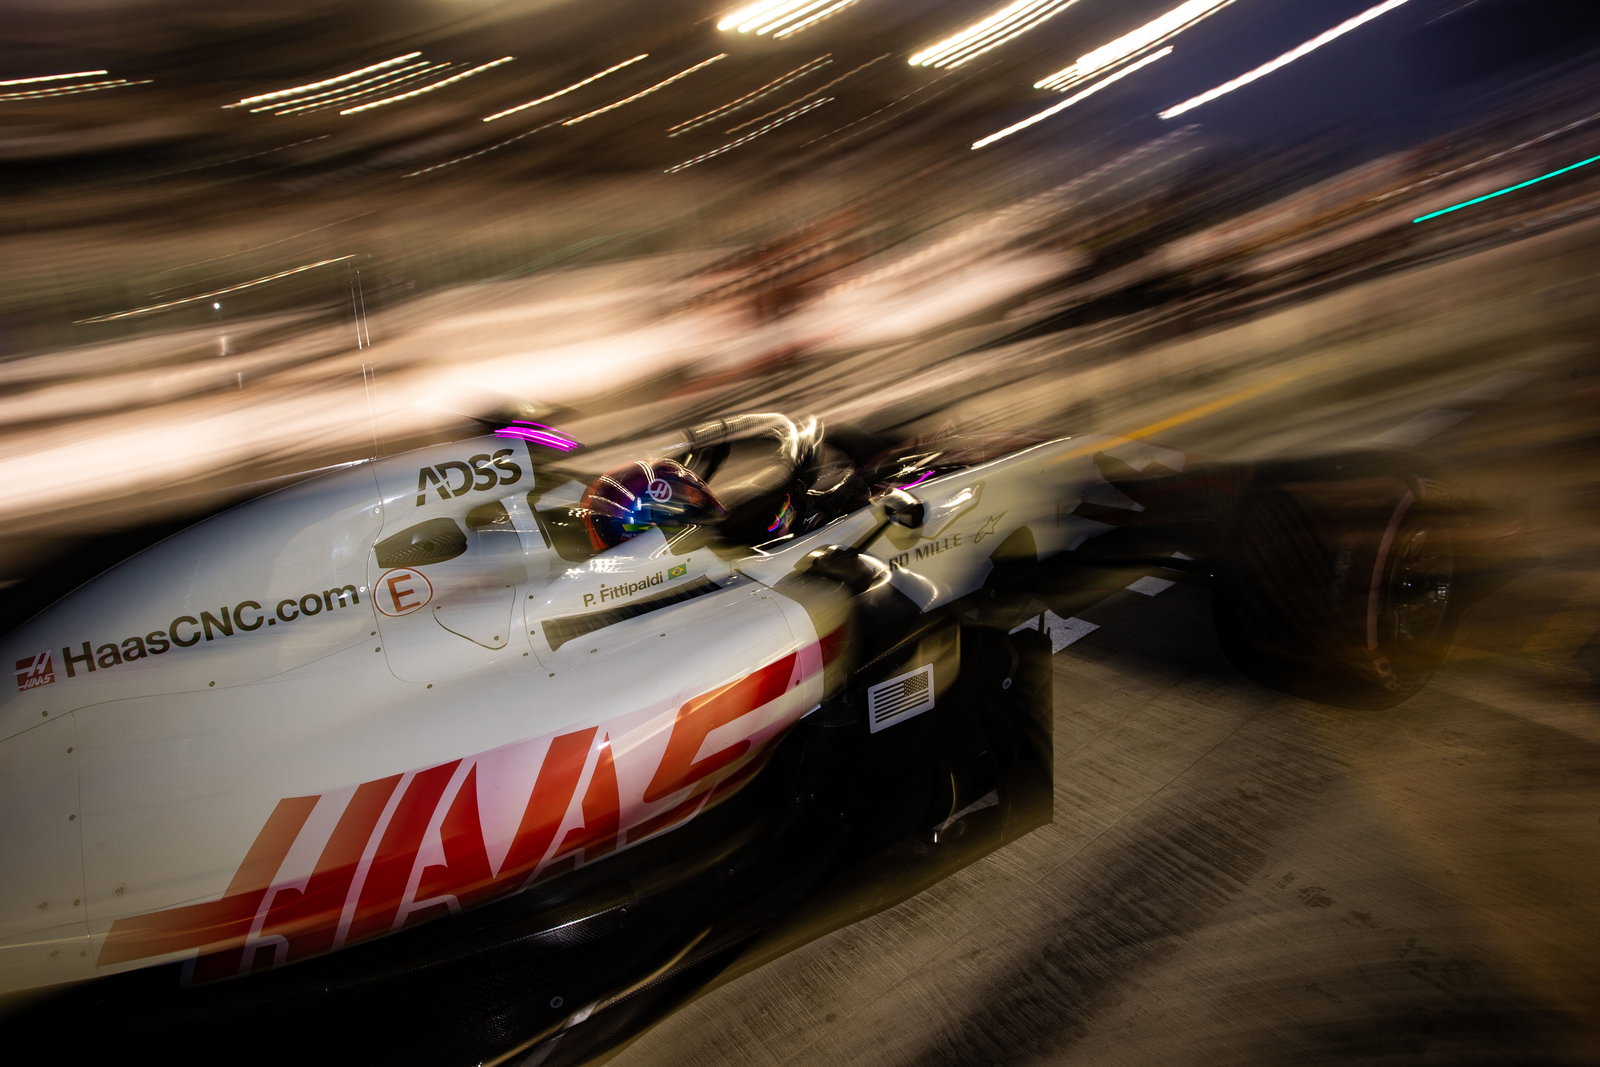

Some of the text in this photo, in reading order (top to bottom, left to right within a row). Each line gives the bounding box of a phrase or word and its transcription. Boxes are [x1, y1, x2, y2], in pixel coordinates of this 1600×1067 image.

[415, 448, 522, 507] ADSS
[916, 533, 962, 561] MILLE
[388, 573, 422, 613] E
[583, 571, 664, 608] P. Fittipaldi
[62, 583, 360, 677] HaasCNC.com
[19, 672, 54, 689] HAAS
[96, 650, 799, 987] HAAS
